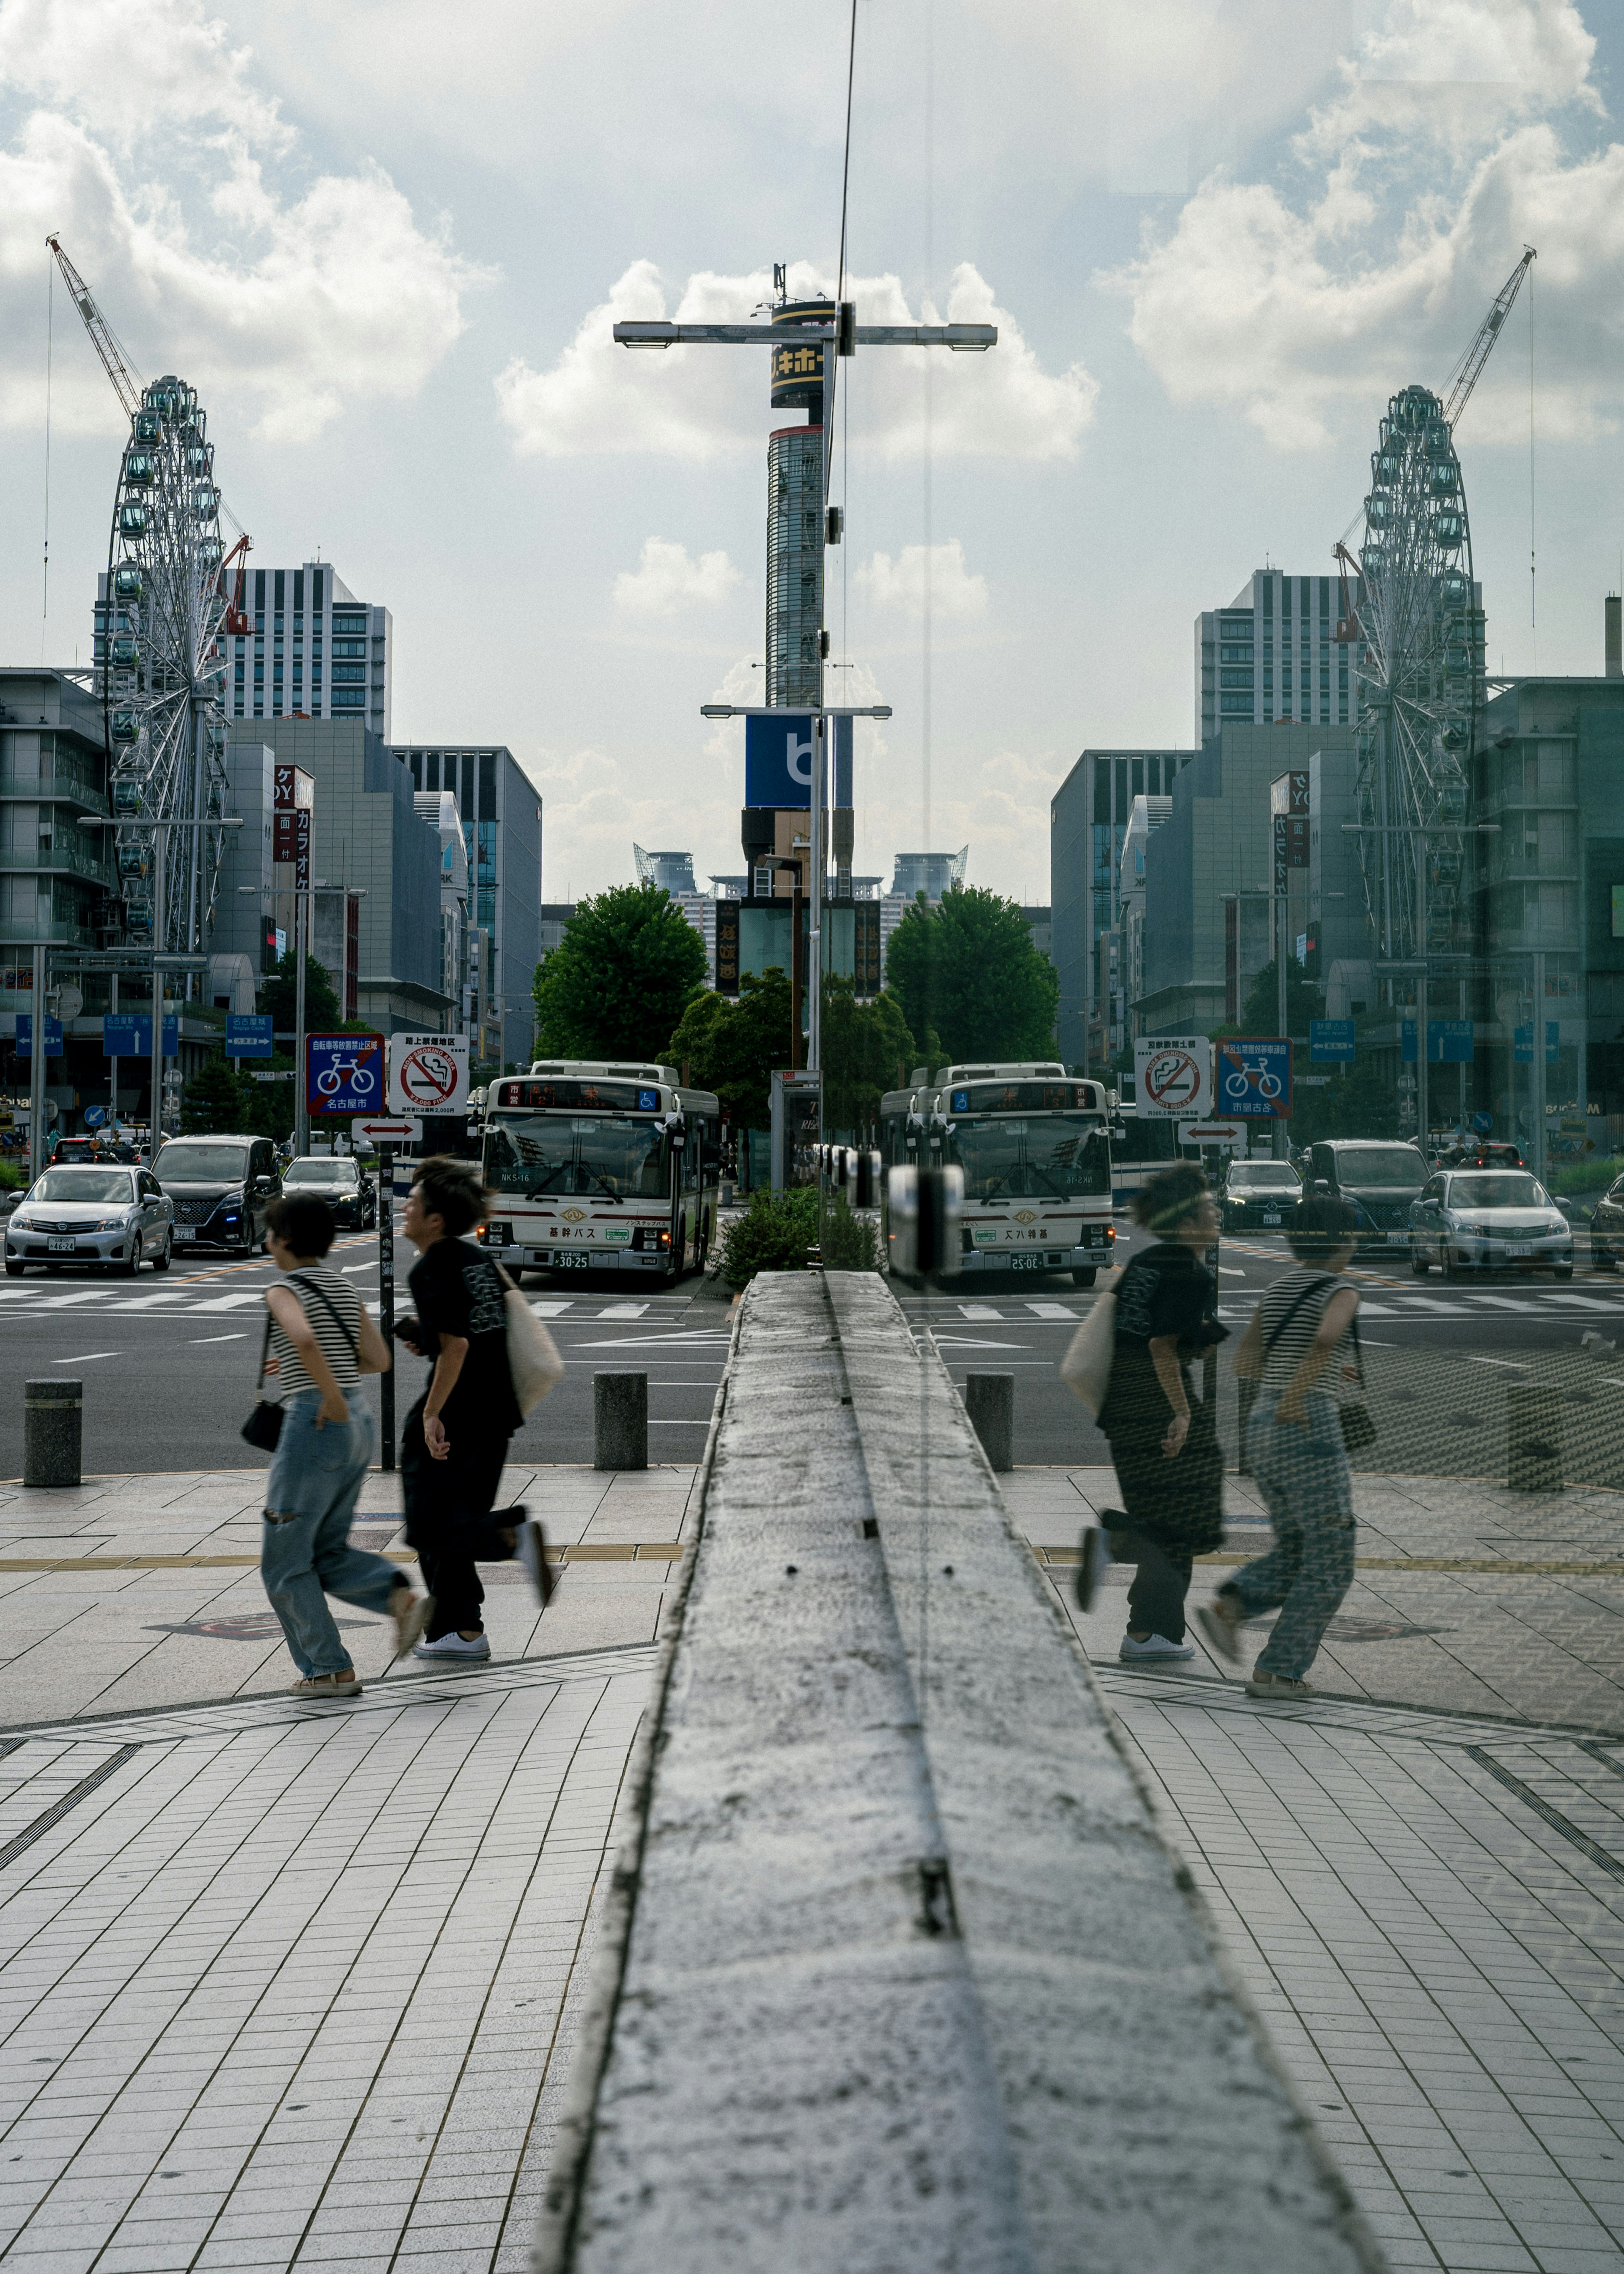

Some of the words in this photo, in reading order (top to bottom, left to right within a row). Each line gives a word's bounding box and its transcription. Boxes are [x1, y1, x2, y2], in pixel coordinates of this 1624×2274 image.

[233, 1017, 266, 1025] 名古屋城
[313, 1041, 378, 1050] 自転車等放置禁止区域
[406, 1037, 455, 1046] 路上禁煙地区
[444, 1055, 456, 1071] AREA
[510, 1085, 518, 1104] 市営
[327, 1099, 367, 1109] 名古屋市
[433, 1095, 447, 1105] FINE
[538, 1096, 546, 1104] 2
[549, 1227, 595, 1238] 基幹バス
[560, 1257, 587, 1268] 30-25
